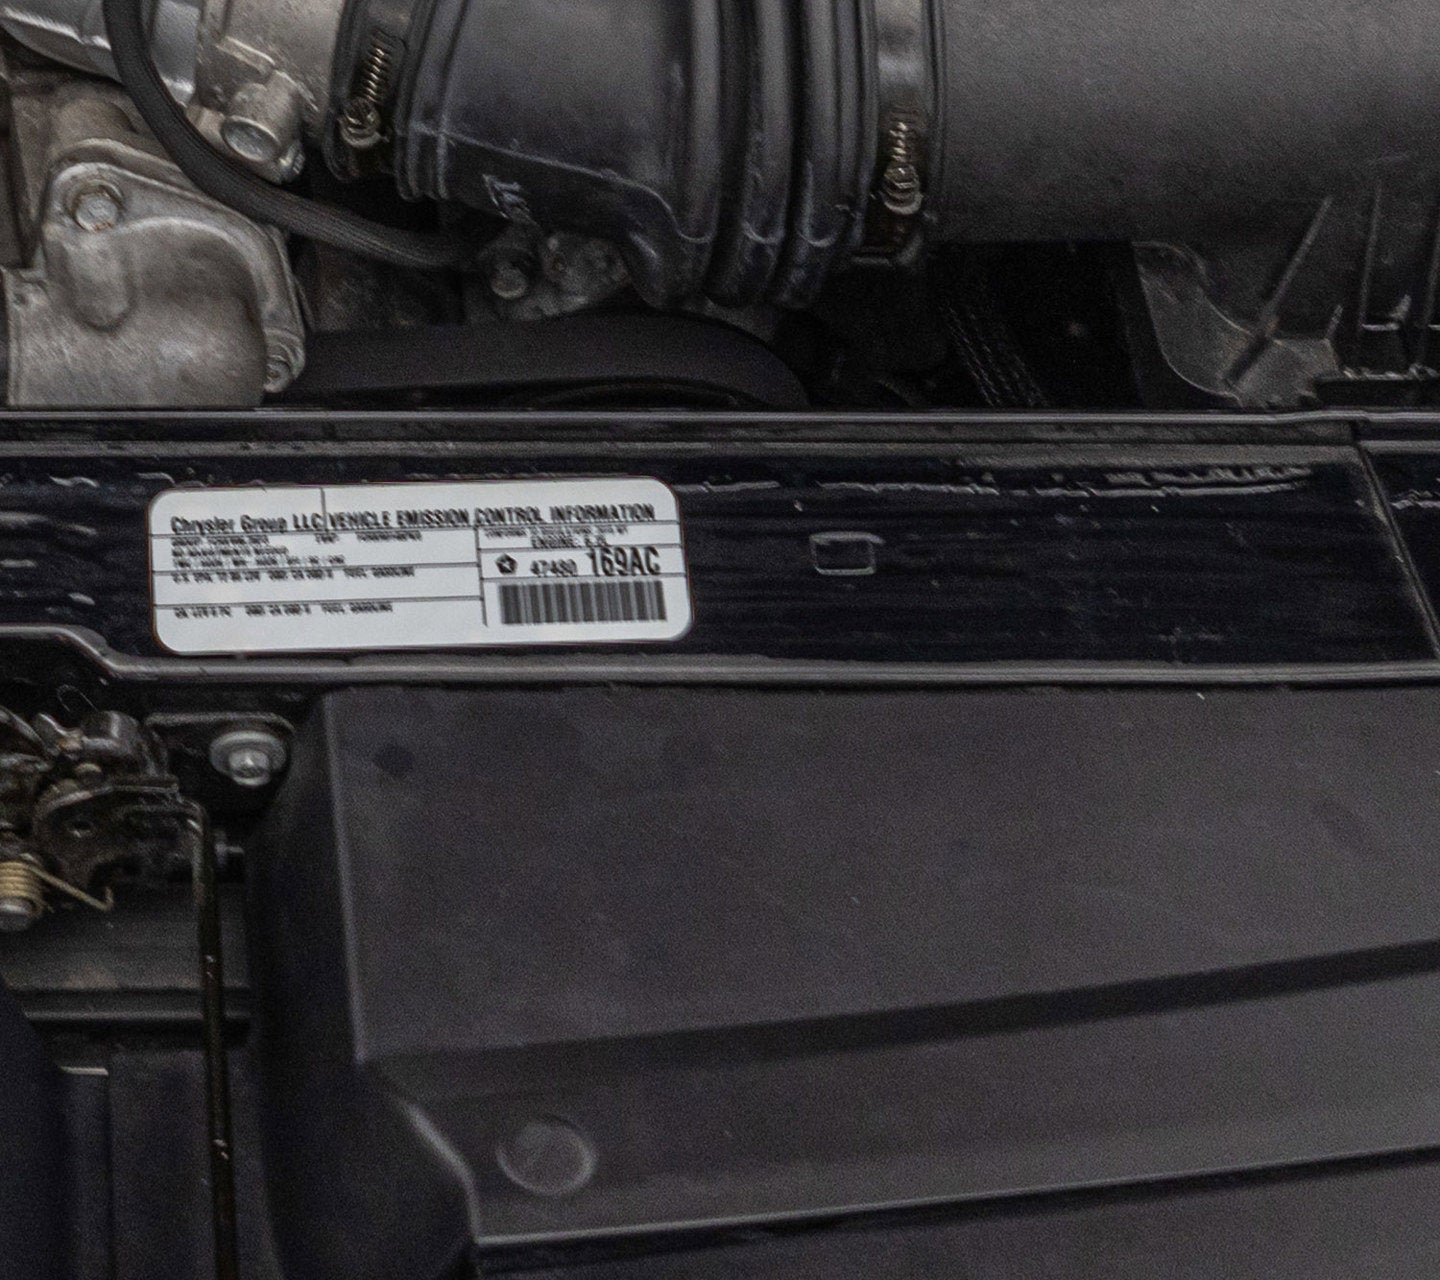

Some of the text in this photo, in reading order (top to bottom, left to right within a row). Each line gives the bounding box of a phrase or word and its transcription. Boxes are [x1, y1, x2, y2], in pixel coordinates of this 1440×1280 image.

[171, 503, 656, 536] Chrysler Group LLC VEHICLE EMISSION CONTROL INFORMATION
[586, 547, 661, 576] 169AC
